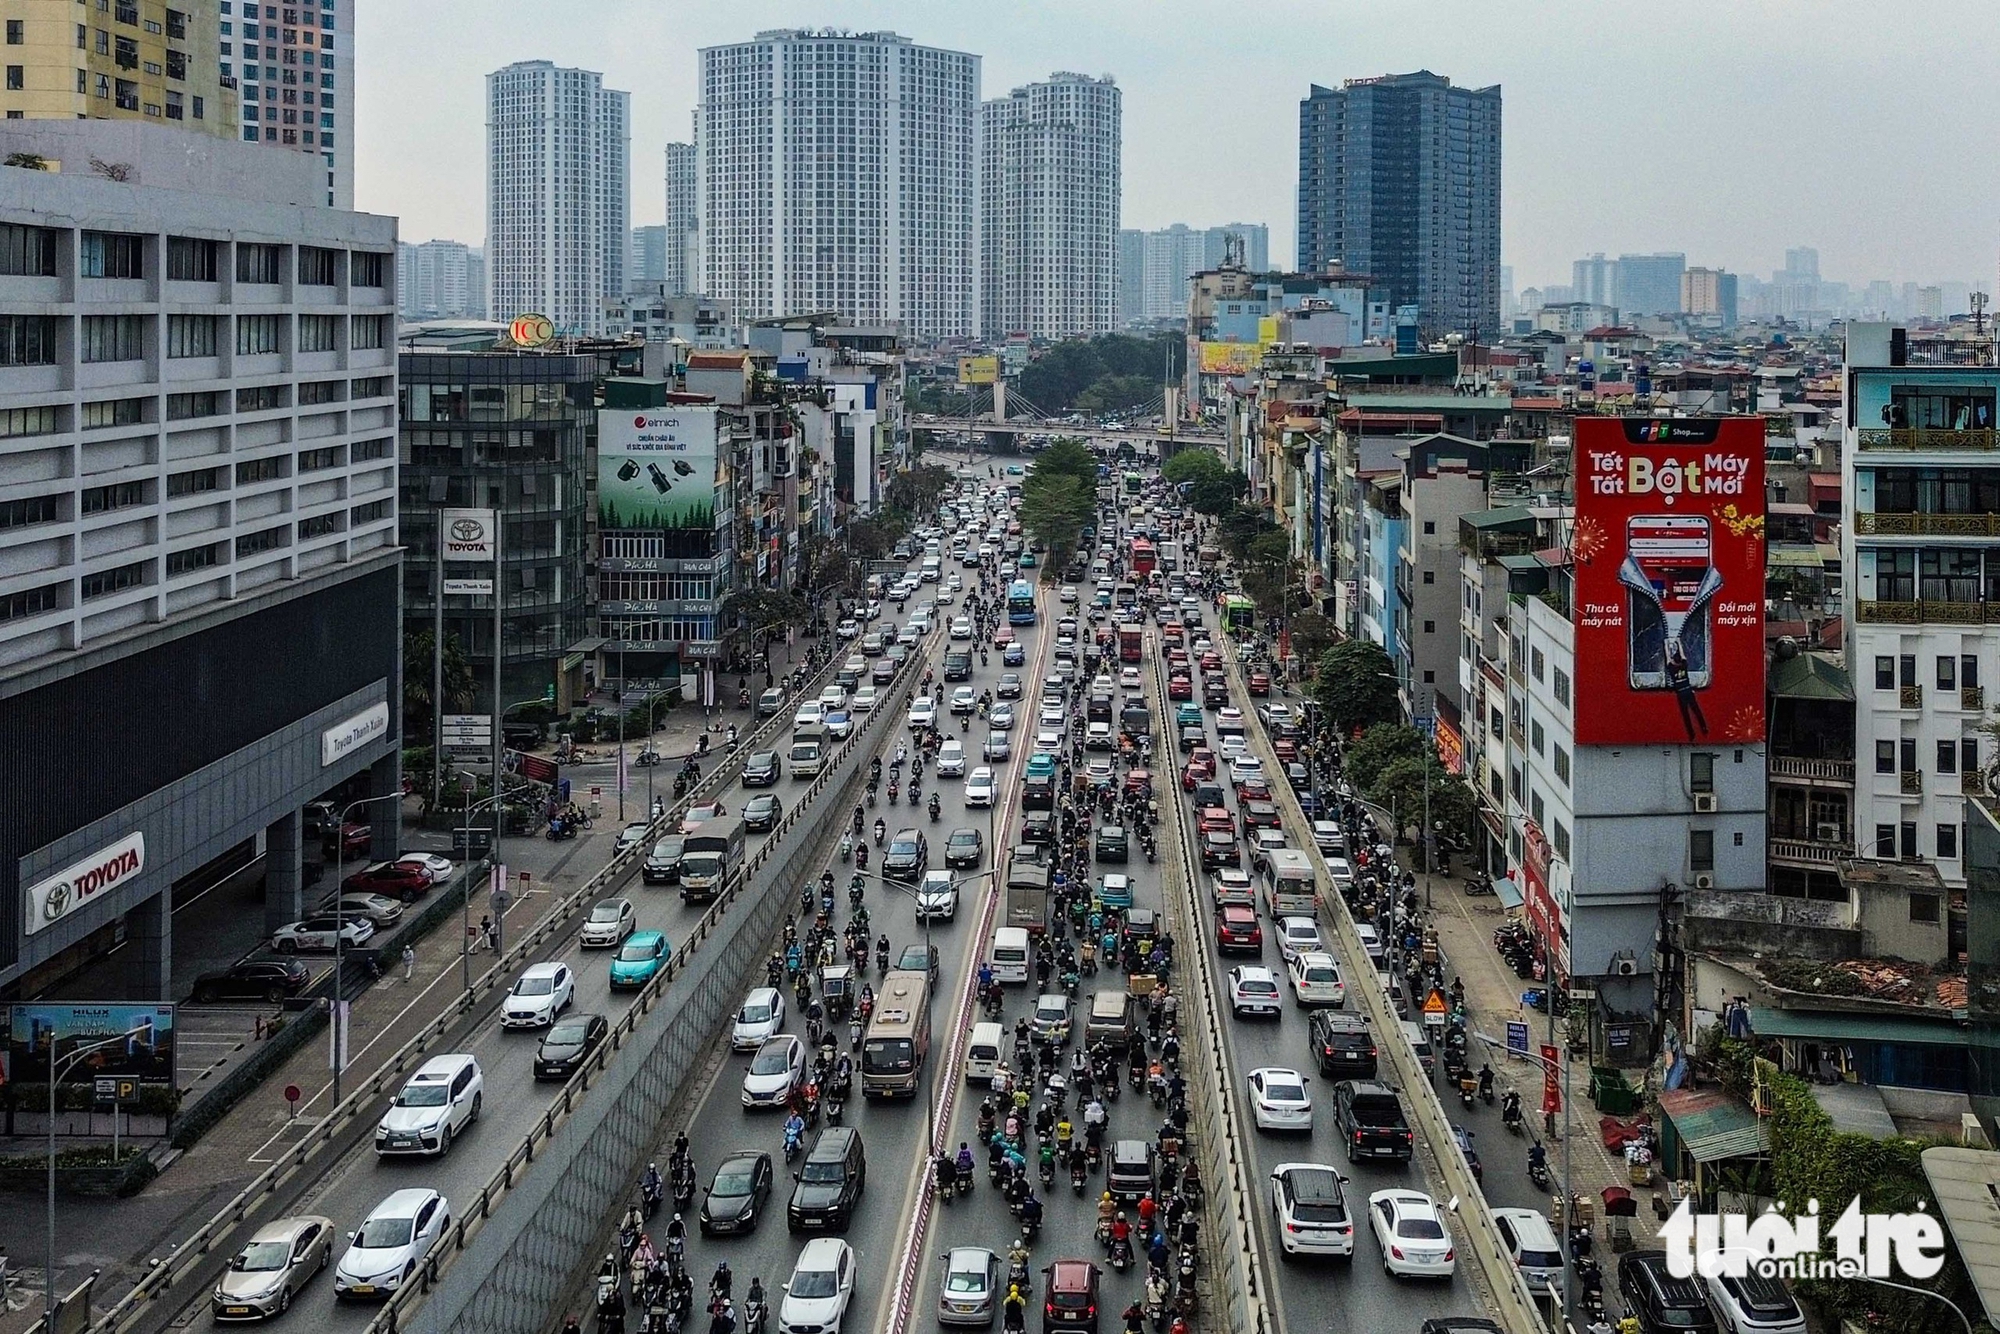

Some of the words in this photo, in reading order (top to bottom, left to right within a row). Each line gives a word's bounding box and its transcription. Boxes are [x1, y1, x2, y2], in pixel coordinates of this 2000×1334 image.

[515, 321, 551, 340] ICC
[647, 418, 680, 428] elmich
[1704, 453, 1749, 476] Máy
[1590, 473, 1624, 494] Tất
[1628, 457, 1700, 505] Bật
[448, 543, 487, 552] TOYOTA
[1585, 603, 1605, 613] Thu
[1581, 616, 1603, 627] máy
[1604, 616, 1622, 626] nát
[1717, 615, 1739, 626] máy
[1741, 614, 1757, 626] xịn
[333, 734, 353, 752] Toyota
[353, 722, 370, 741] Thanh
[73, 848, 140, 901] TOYOTA
[120, 1082, 133, 1097] P
